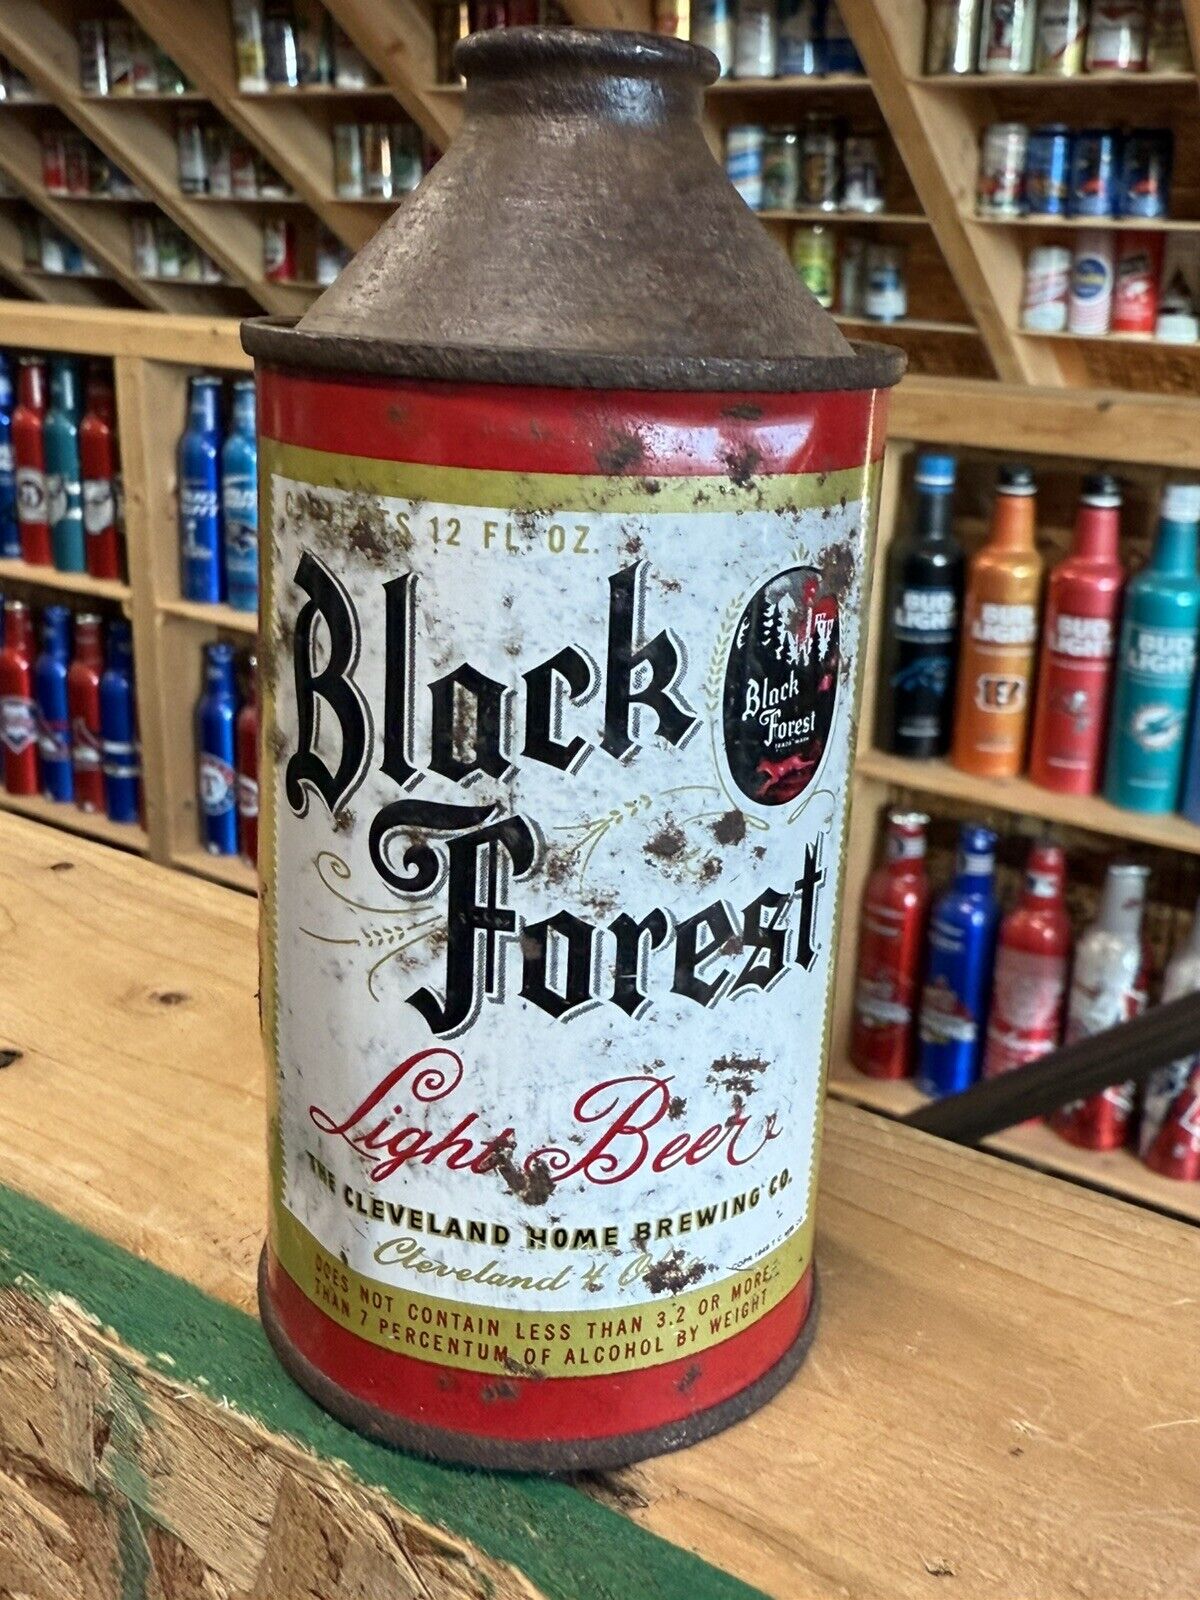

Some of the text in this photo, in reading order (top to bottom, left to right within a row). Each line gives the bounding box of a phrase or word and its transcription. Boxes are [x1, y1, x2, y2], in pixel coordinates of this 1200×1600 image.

[429, 516, 462, 547] 12
[548, 524, 599, 555] OZ.
[286, 548, 704, 819] Black
[741, 669, 799, 722] Black
[758, 708, 816, 747] Forest
[368, 798, 827, 1040] Forest
[309, 1047, 784, 1185] Light Beer
[342, 1185, 511, 1247] CLEVELAND
[524, 1225, 620, 1251] HOME
[635, 1187, 761, 1243] BREWING
[768, 1167, 793, 1197] CO.
[314, 1254, 350, 1292] DOES
[359, 1285, 394, 1313] NOT
[408, 1303, 500, 1337] CONTAIN
[516, 1322, 571, 1341] LESS
[587, 1315, 643, 1339] THAN
[656, 1305, 686, 1329] 3.2
[698, 1293, 720, 1316] OR
[731, 1264, 771, 1301] MORE
[372, 1236, 574, 1292] Cleveland
[314, 1276, 769, 1366] THAN 7 PERCENTUM OF ALCOHOL BY WEIGHT
